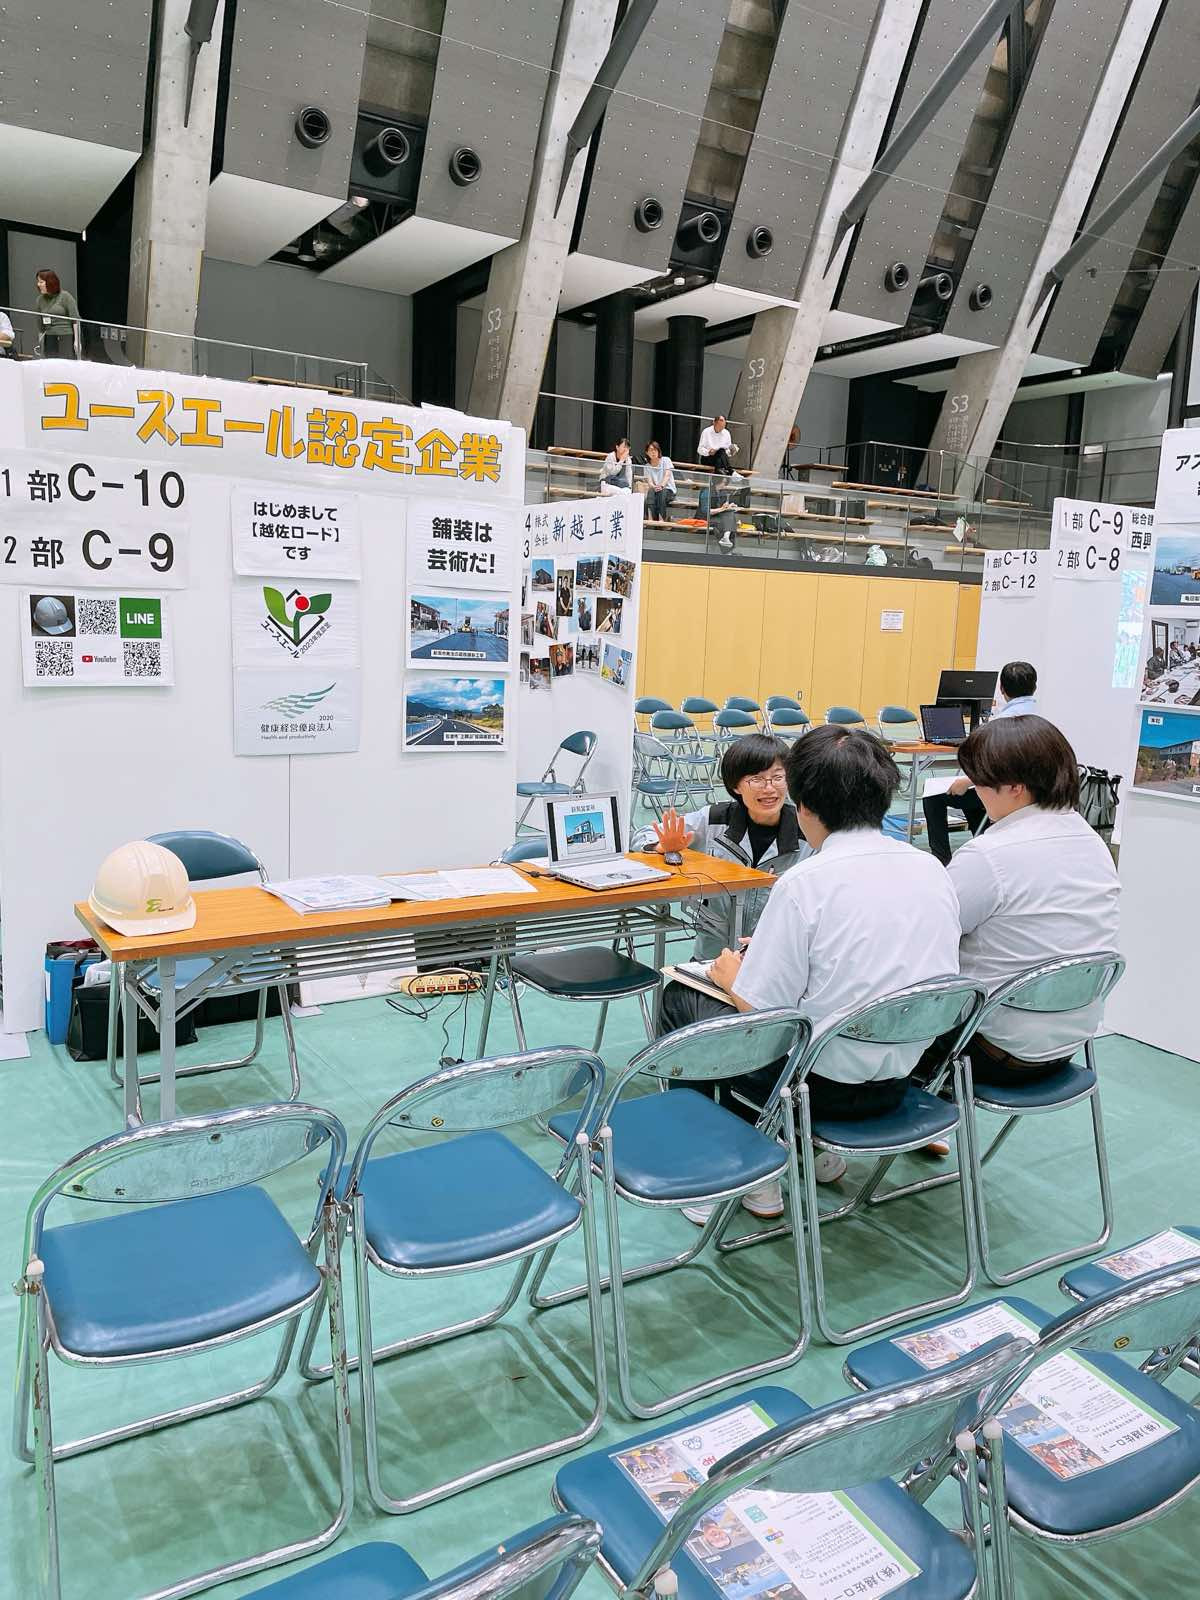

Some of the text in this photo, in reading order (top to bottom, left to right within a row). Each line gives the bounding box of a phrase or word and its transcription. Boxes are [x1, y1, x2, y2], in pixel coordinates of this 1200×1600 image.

[748, 358, 765, 379] S3
[951, 394, 969, 414] S3
[40, 380, 503, 484] ユースエール認定企業
[68, 462, 185, 509] C-10
[253, 501, 338, 522] はじめまして
[252, 521, 340, 543] 【越佐ロード】
[431, 516, 493, 543] 舗装は
[552, 510, 624, 542] 新越工業
[82, 529, 175, 573] C-9
[282, 546, 312, 561] です
[427, 548, 496, 574] 芸術だ!
[126, 612, 155, 625] LINE
[260, 620, 301, 660] ユースエール
[260, 722, 335, 733] 健康経営優良法人
[319, 714, 334, 722] 2020
[824, 1562, 902, 1600] (株)越佐ロー
